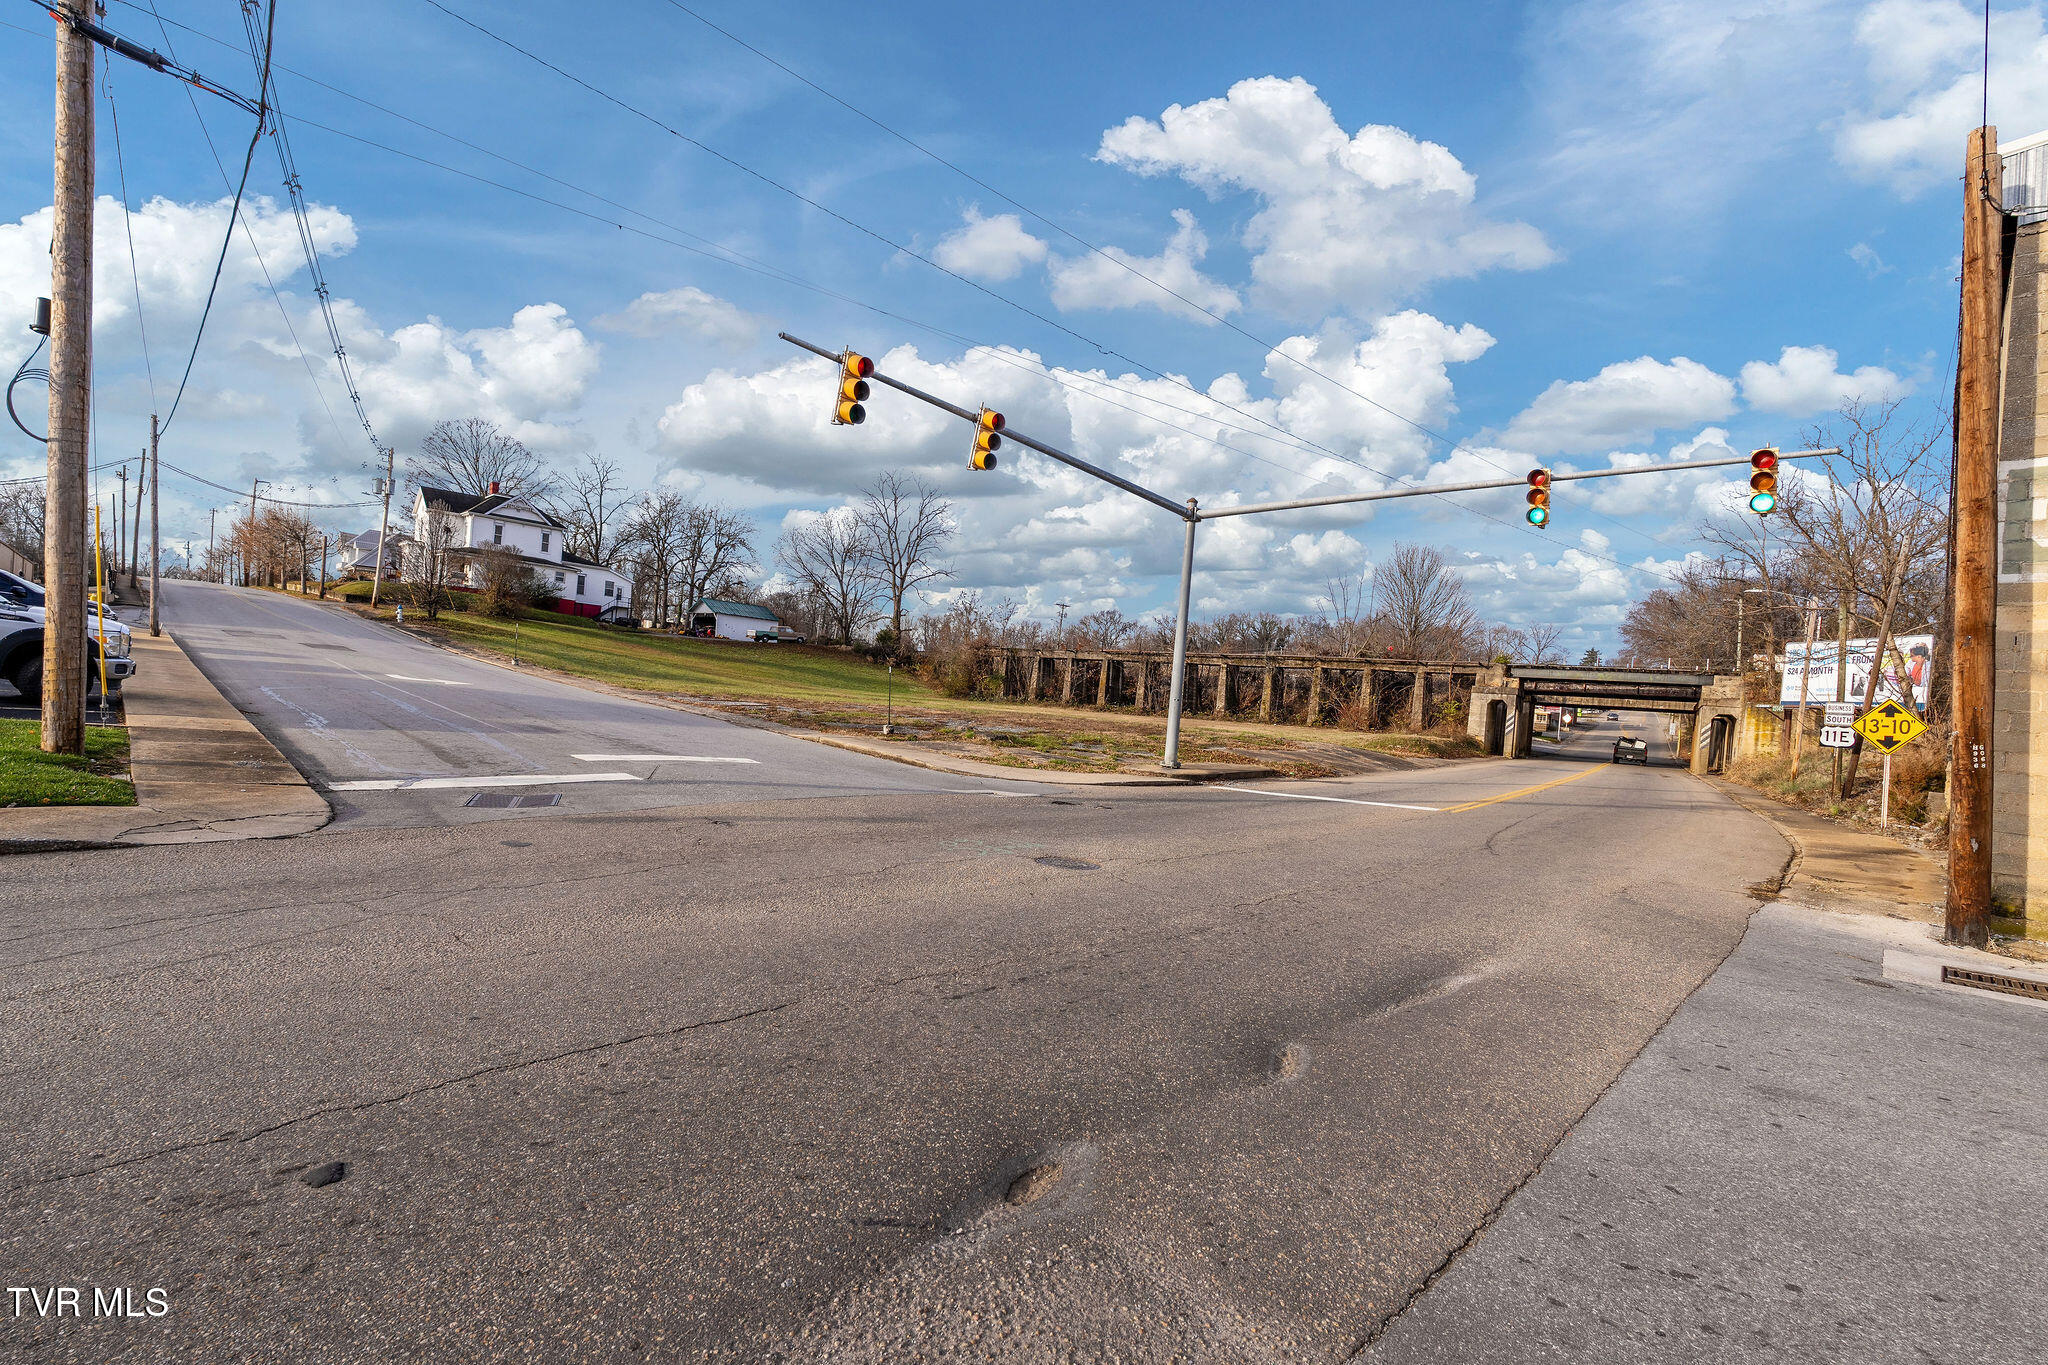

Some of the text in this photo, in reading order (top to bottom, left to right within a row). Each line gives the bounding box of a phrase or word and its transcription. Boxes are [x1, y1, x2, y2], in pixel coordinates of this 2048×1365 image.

[1808, 666, 1833, 675] MONTH
[1826, 715, 1852, 723] SOUTH
[1825, 730, 1850, 743] 11E
